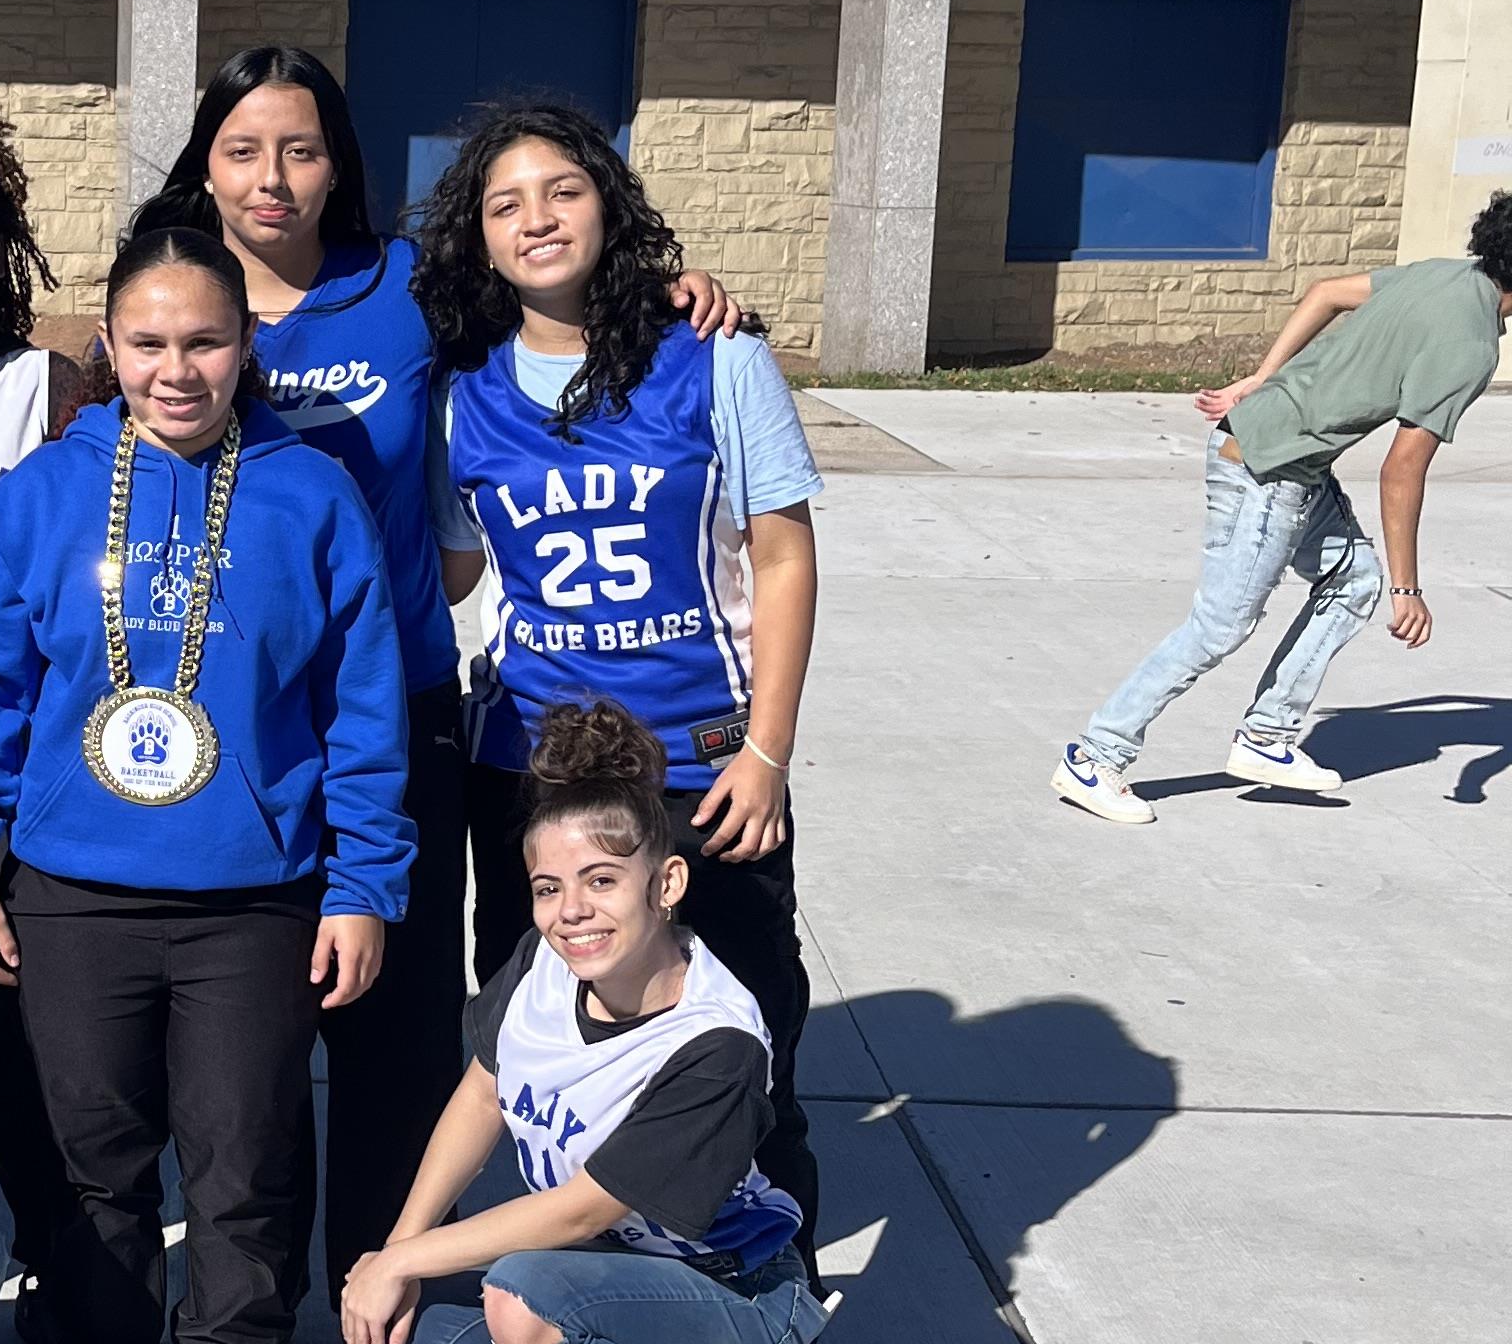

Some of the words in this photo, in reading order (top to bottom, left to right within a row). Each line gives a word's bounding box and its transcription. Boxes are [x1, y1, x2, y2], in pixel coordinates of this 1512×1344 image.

[496, 463, 666, 530] LADY
[535, 523, 653, 607] 25
[514, 619, 587, 652] BLUE
[594, 607, 703, 651] BEARS
